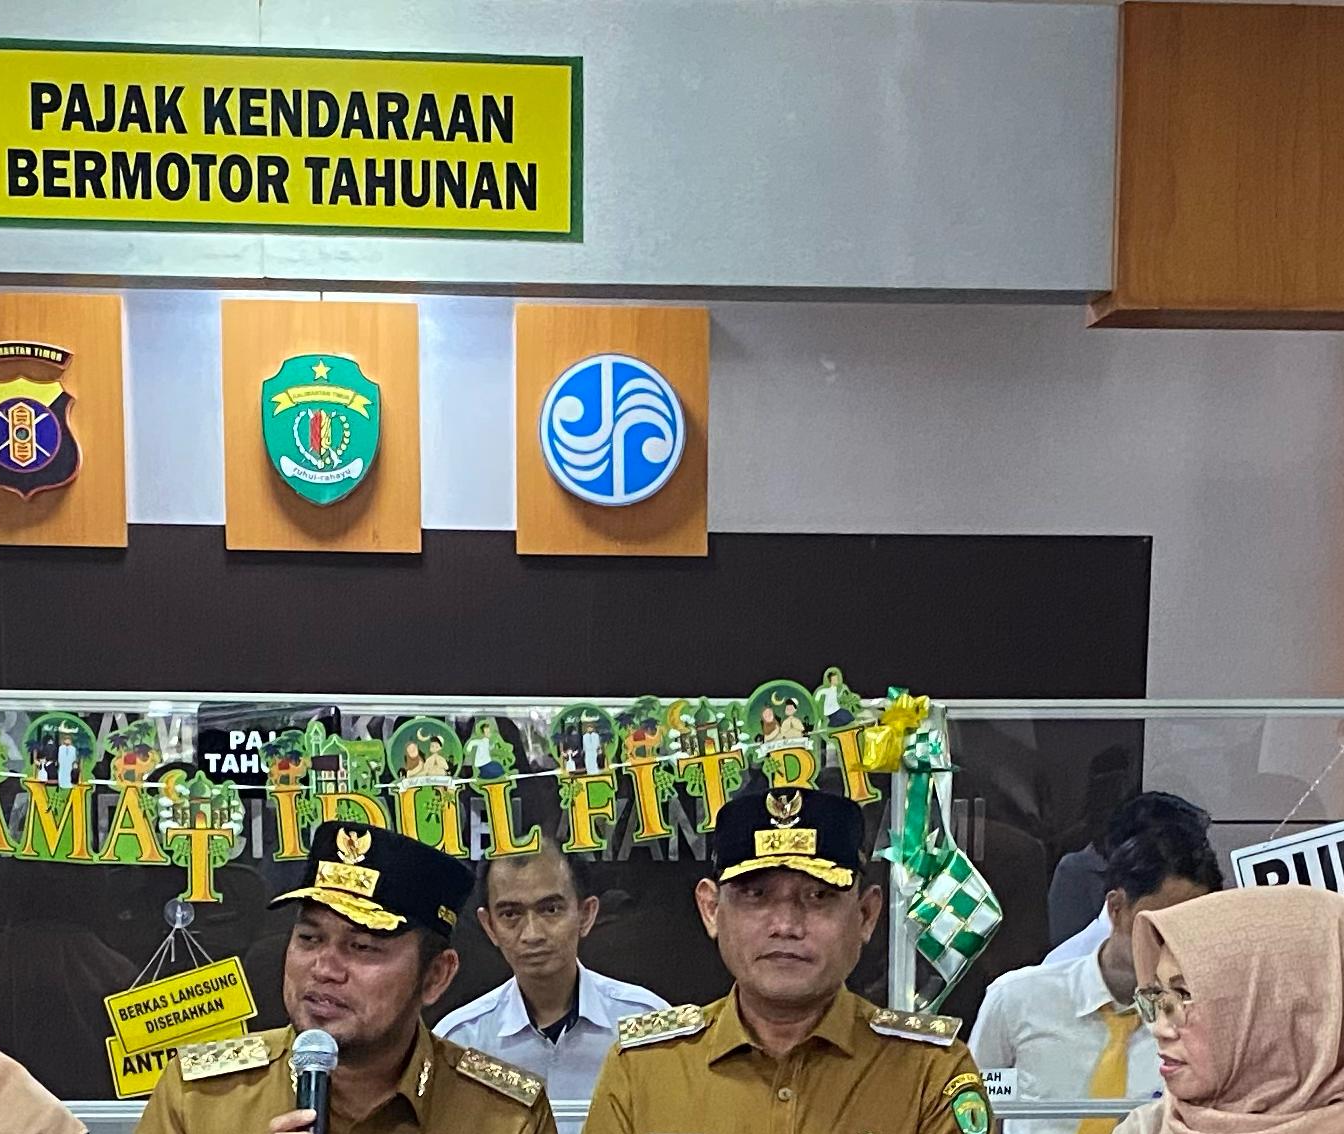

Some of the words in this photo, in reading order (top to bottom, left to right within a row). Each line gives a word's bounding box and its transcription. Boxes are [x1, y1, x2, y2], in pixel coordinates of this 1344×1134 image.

[30, 82, 187, 134] PAJAK
[203, 86, 513, 143] KENDARAAN
[7, 148, 289, 204] BERMOTOR
[304, 157, 537, 211] TAHUNAN
[34, 347, 63, 362] TIMUR
[273, 783, 540, 859] IDUL
[563, 727, 878, 850] FITRI
[118, 995, 168, 1021] BERKAS
[170, 973, 238, 1004] LANGSUNG
[145, 998, 225, 1033] DISERAHKAN
[986, 1086, 1012, 1095] HAN
